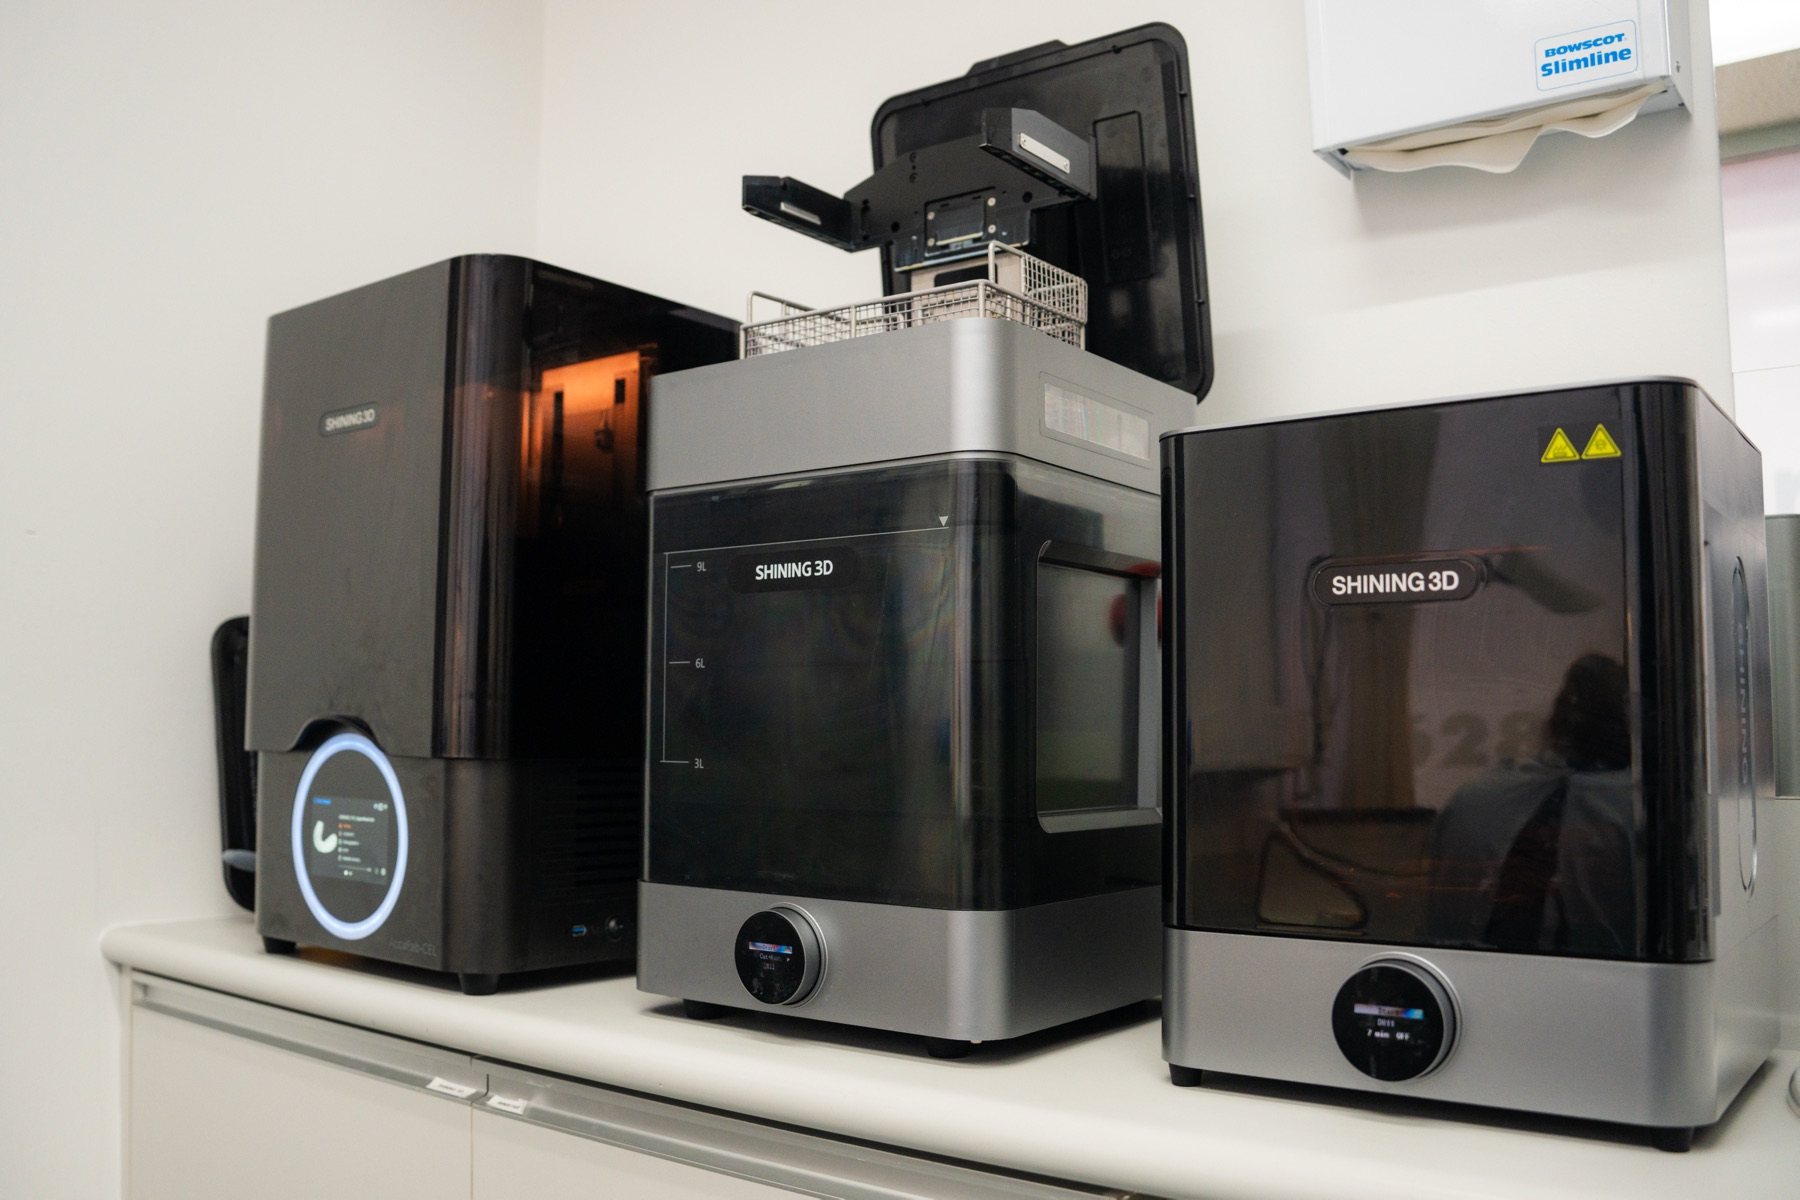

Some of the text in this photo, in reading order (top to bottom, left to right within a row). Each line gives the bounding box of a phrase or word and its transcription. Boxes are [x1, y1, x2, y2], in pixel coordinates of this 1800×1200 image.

[1544, 33, 1625, 58] BOWSCOT
[1540, 48, 1632, 77] Slimline
[696, 561, 707, 572] 9L
[755, 559, 834, 581] SHINING 3D
[1331, 570, 1460, 596] SHINING 3D
[695, 658, 706, 669] 6L
[693, 757, 705, 769] 3L
